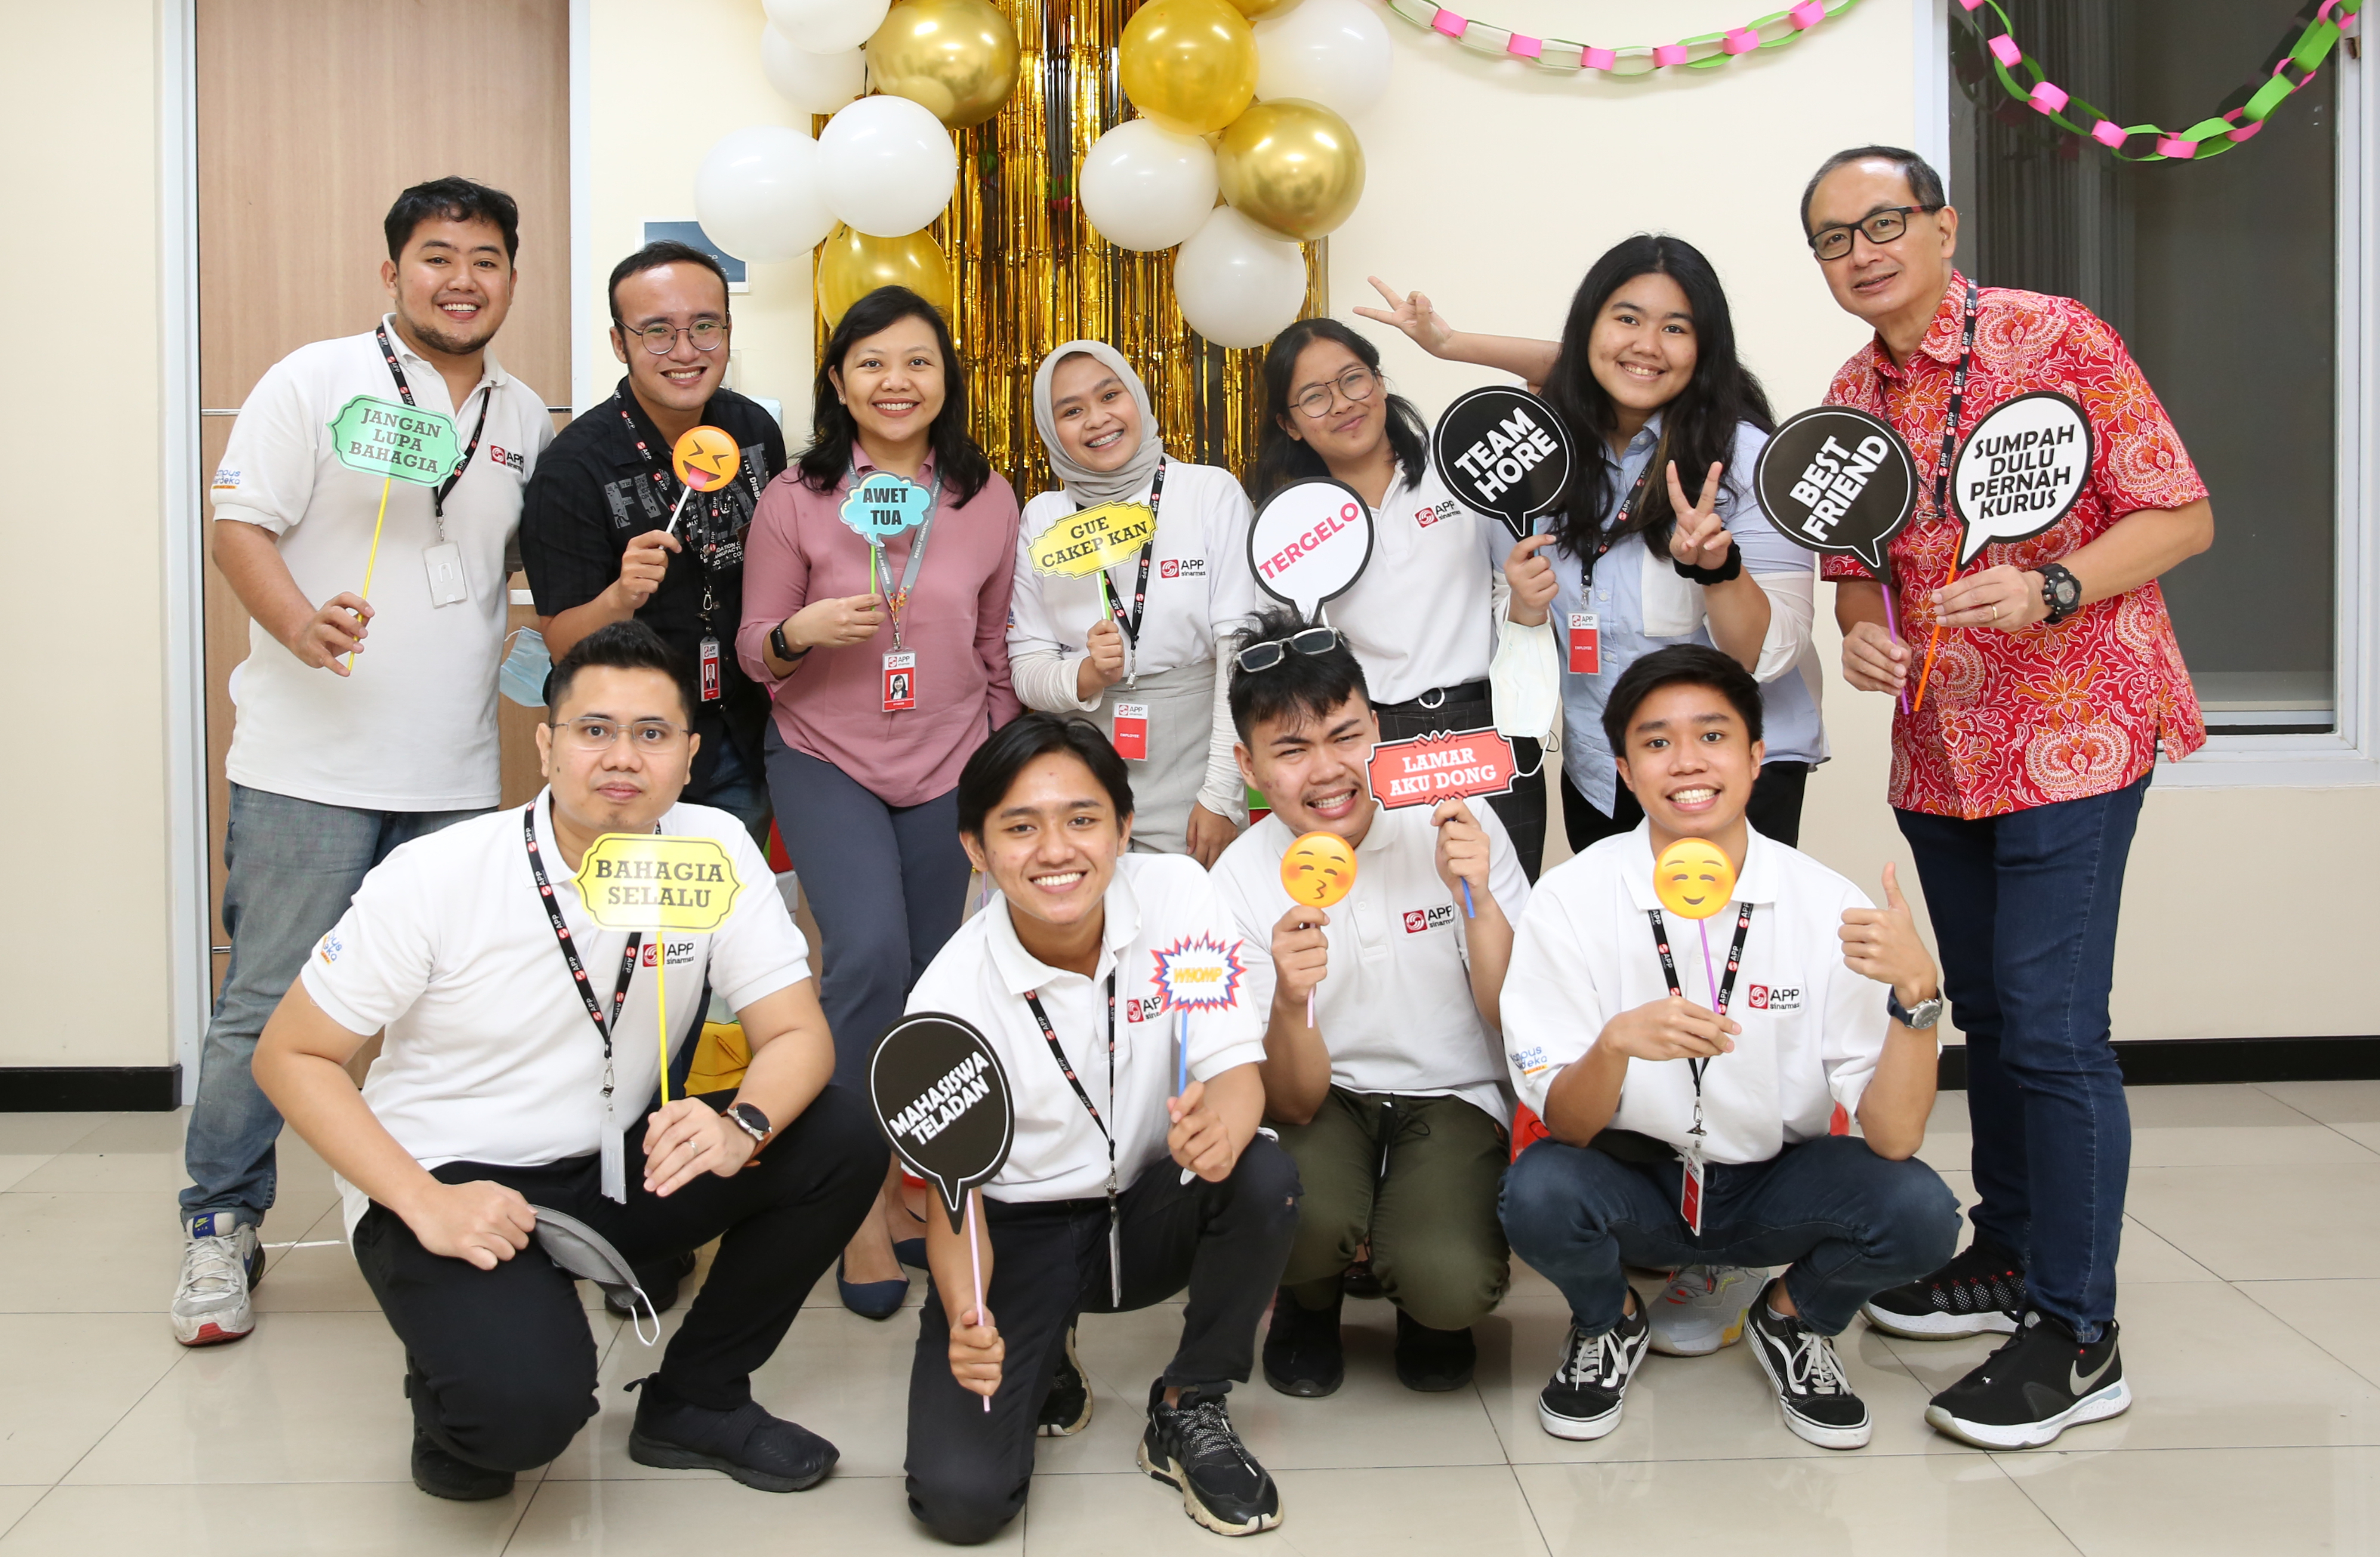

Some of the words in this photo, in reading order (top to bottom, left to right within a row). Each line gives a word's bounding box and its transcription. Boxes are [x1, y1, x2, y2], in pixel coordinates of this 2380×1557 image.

[392, 362, 400, 373] APP
[405, 394, 413, 405] APP
[361, 408, 442, 438] JANGAN
[626, 418, 635, 429] APP
[373, 429, 422, 452] LUPA
[1454, 407, 1536, 478] TEAM
[1974, 424, 2075, 459] SUMPAH
[349, 441, 438, 473] BAHAGIA
[642, 449, 652, 461] APP
[1990, 448, 2055, 476] DULU
[1474, 427, 1558, 503] HORE
[1790, 435, 1850, 508] BEST
[658, 479, 667, 491] APP
[1802, 436, 1888, 542] FRIEND
[1970, 466, 2070, 501] PERNAH
[863, 488, 908, 503] AWET
[1435, 501, 1454, 515] APP
[1622, 499, 1630, 512] APP
[1979, 489, 2056, 520] KURUS
[871, 510, 902, 525] TUA
[1071, 516, 1109, 538] GUE
[1041, 537, 1103, 567] CAKEP
[1107, 521, 1148, 546] KAN
[1259, 503, 1358, 579] TERGELO
[1181, 560, 1204, 570] APP
[1111, 599, 1119, 609] APP
[1402, 748, 1476, 772] LAMAR
[1390, 775, 1430, 797] AKU
[1434, 764, 1497, 788] DONG
[535, 871, 545, 886] APP
[595, 859, 724, 882] BAHAGIA
[608, 886, 711, 908] SELALU
[1428, 905, 1452, 920] APP
[1652, 910, 1661, 925] APP
[552, 914, 563, 929] APP
[667, 943, 694, 957] APP
[1730, 945, 1738, 961] APP
[569, 956, 578, 971] APP
[626, 957, 634, 973] APP
[666, 956, 694, 965] sinarmas
[1663, 954, 1672, 968] APP
[1173, 967, 1222, 983] WHOMP
[1719, 988, 1728, 1004] APP
[1770, 989, 1799, 1001] APP
[586, 997, 597, 1012] APP
[1143, 995, 1162, 1012] AP
[1037, 1016, 1049, 1030] APP
[1057, 1057, 1068, 1071] APP
[889, 1051, 990, 1137] MAHASISWA
[910, 1074, 990, 1145] TELADAN
